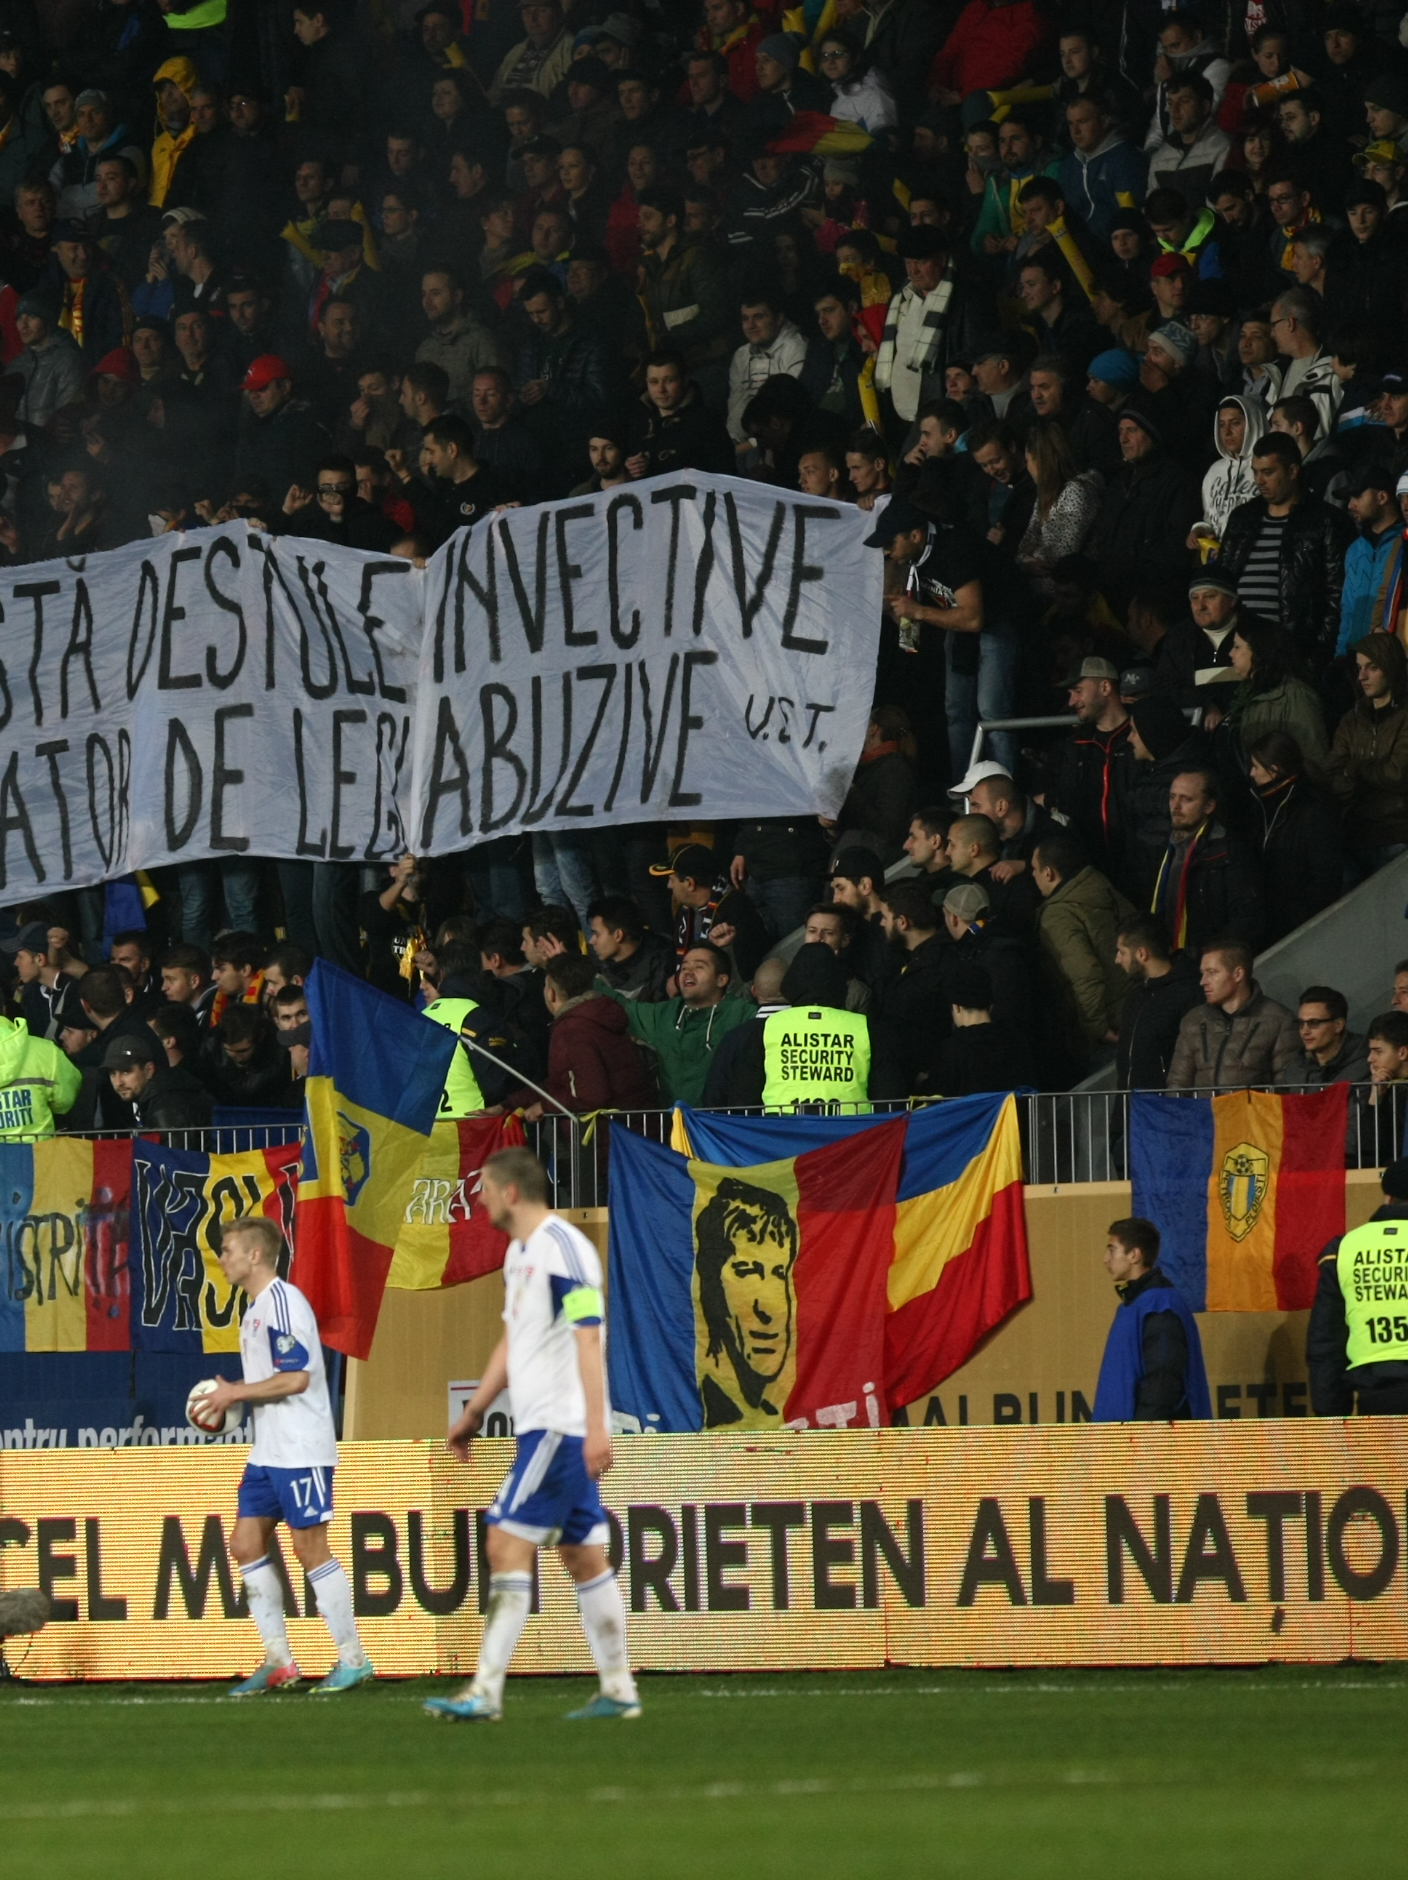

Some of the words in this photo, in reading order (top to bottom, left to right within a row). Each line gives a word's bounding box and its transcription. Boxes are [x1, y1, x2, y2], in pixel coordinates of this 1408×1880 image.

[433, 483, 842, 684] INVECTIVE
[163, 702, 255, 853] DE
[420, 651, 719, 850] ABUZIVE
[780, 1032, 855, 1049] ALISTAR
[780, 1048, 854, 1067] SECURITY
[780, 1065, 855, 1083] STEWARD
[405, 1167, 486, 1225] ARA
[289, 1476, 313, 1508] 17
[955, 1496, 1075, 1607] AL
[1105, 1484, 1408, 1636] NAȚIO
